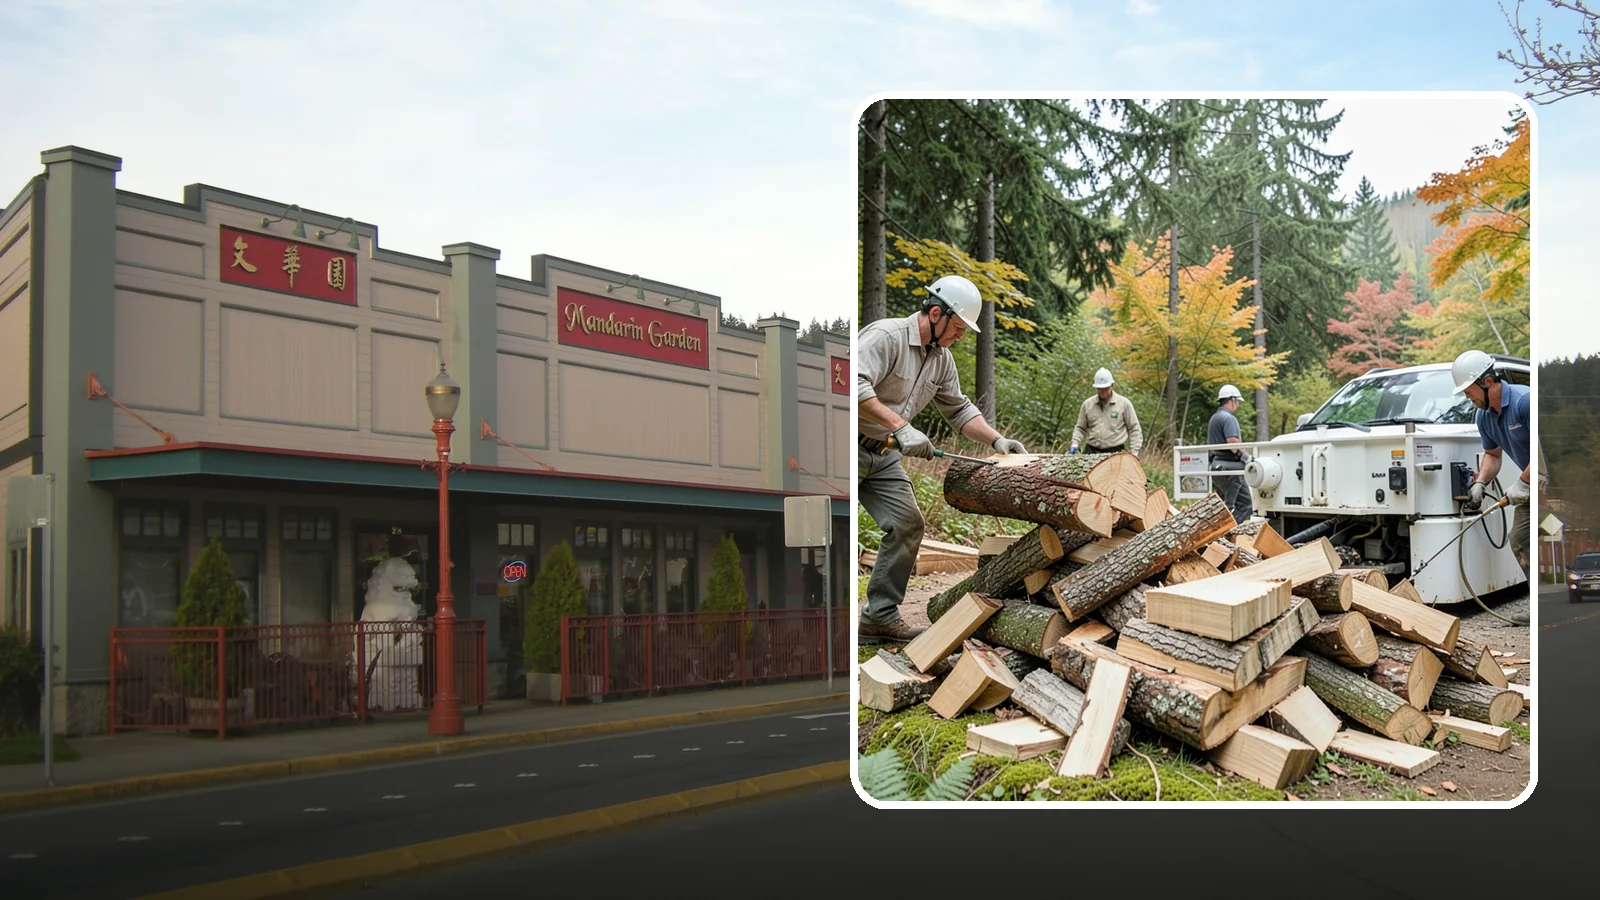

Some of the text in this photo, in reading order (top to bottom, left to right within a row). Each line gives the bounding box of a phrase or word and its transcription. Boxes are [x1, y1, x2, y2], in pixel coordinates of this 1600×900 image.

[230, 235, 346, 291] 文華園
[564, 302, 702, 353] Mandarin Garden
[503, 565, 527, 578] OPEN
